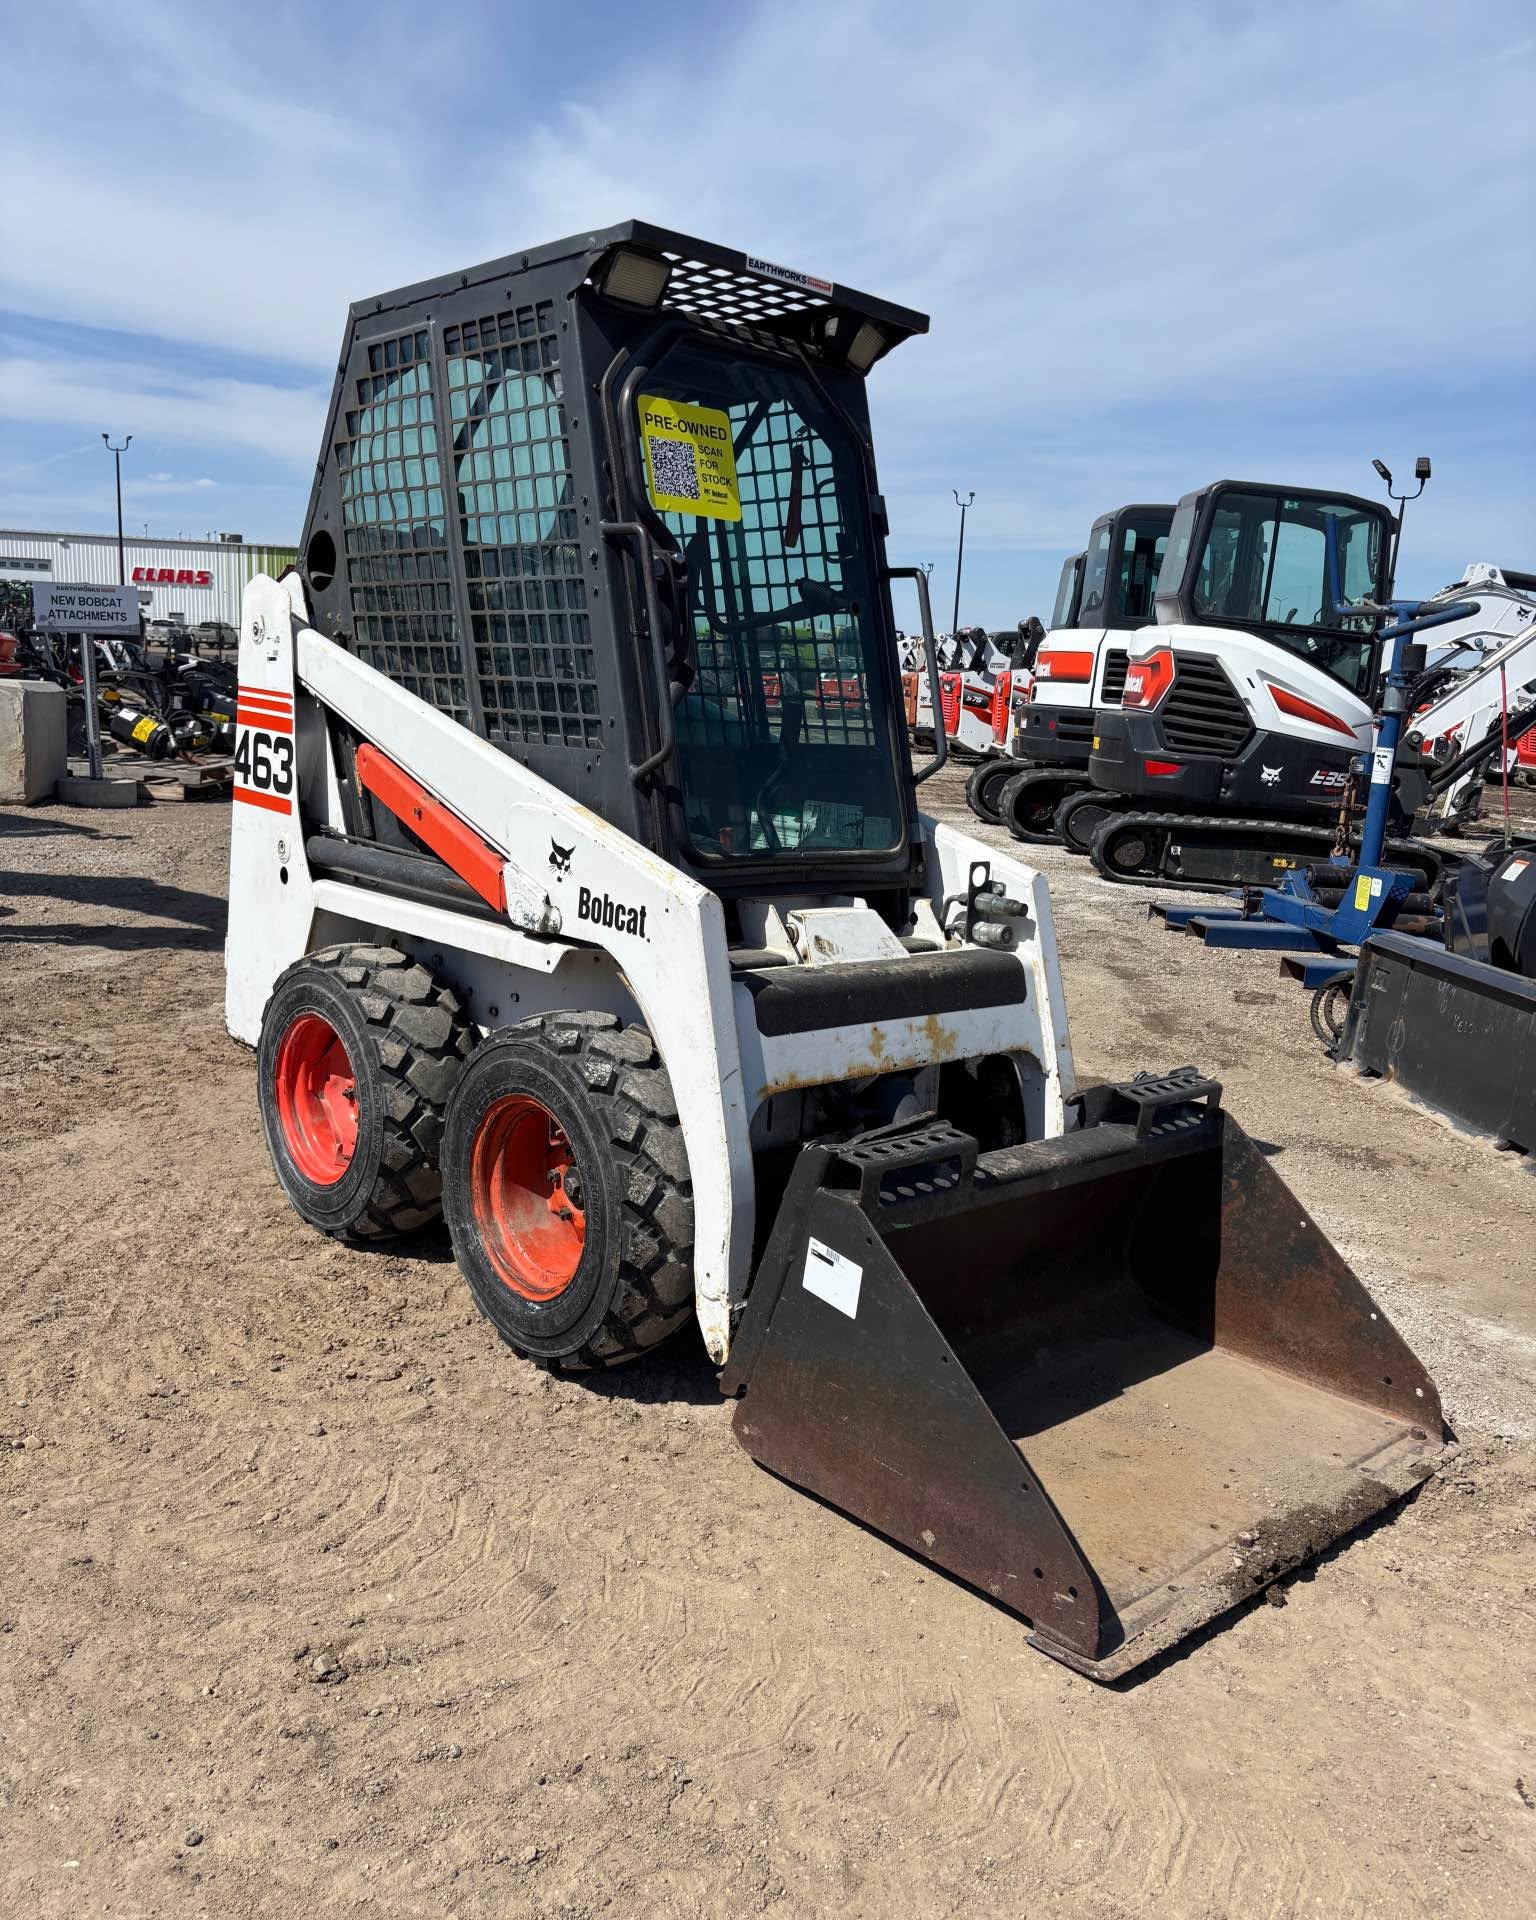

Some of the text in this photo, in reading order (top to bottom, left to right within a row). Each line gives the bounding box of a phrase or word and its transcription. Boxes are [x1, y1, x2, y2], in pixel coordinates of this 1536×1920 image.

[748, 259, 807, 284] EARTHWORKS
[645, 413, 727, 440] PRE-OWNED
[698, 445, 723, 457] SCAN
[700, 459, 718, 470] FOR
[702, 473, 732, 487] STOCK
[132, 567, 210, 586] CLAAS
[51, 595, 122, 608] NEW BOBCAT
[49, 609, 127, 622] ATTACHMENTS
[234, 730, 294, 795] 463
[578, 886, 647, 939] Bobcat
